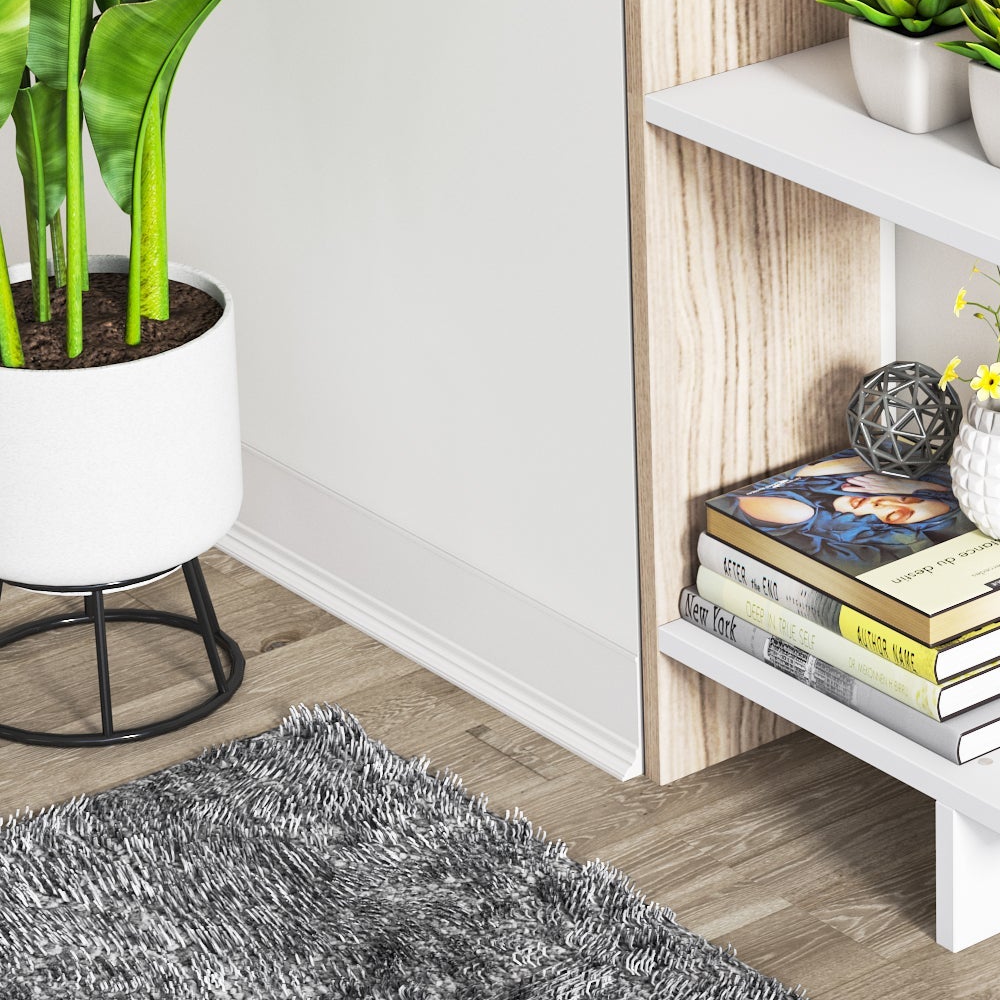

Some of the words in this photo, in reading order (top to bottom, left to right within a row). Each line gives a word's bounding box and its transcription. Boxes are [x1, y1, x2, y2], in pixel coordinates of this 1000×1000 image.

[723, 556, 748, 586] AFTER
[751, 578, 761, 593] the
[762, 576, 779, 601] END
[890, 565, 934, 584] destin
[684, 593, 708, 627] New
[713, 605, 737, 643] York
[746, 599, 765, 627] DEEP
[768, 611, 776, 632] IN
[779, 616, 797, 642] TRUE
[799, 628, 816, 651] SELF
[857, 625, 889, 659] AUTHOR
[892, 643, 917, 673] NAME
